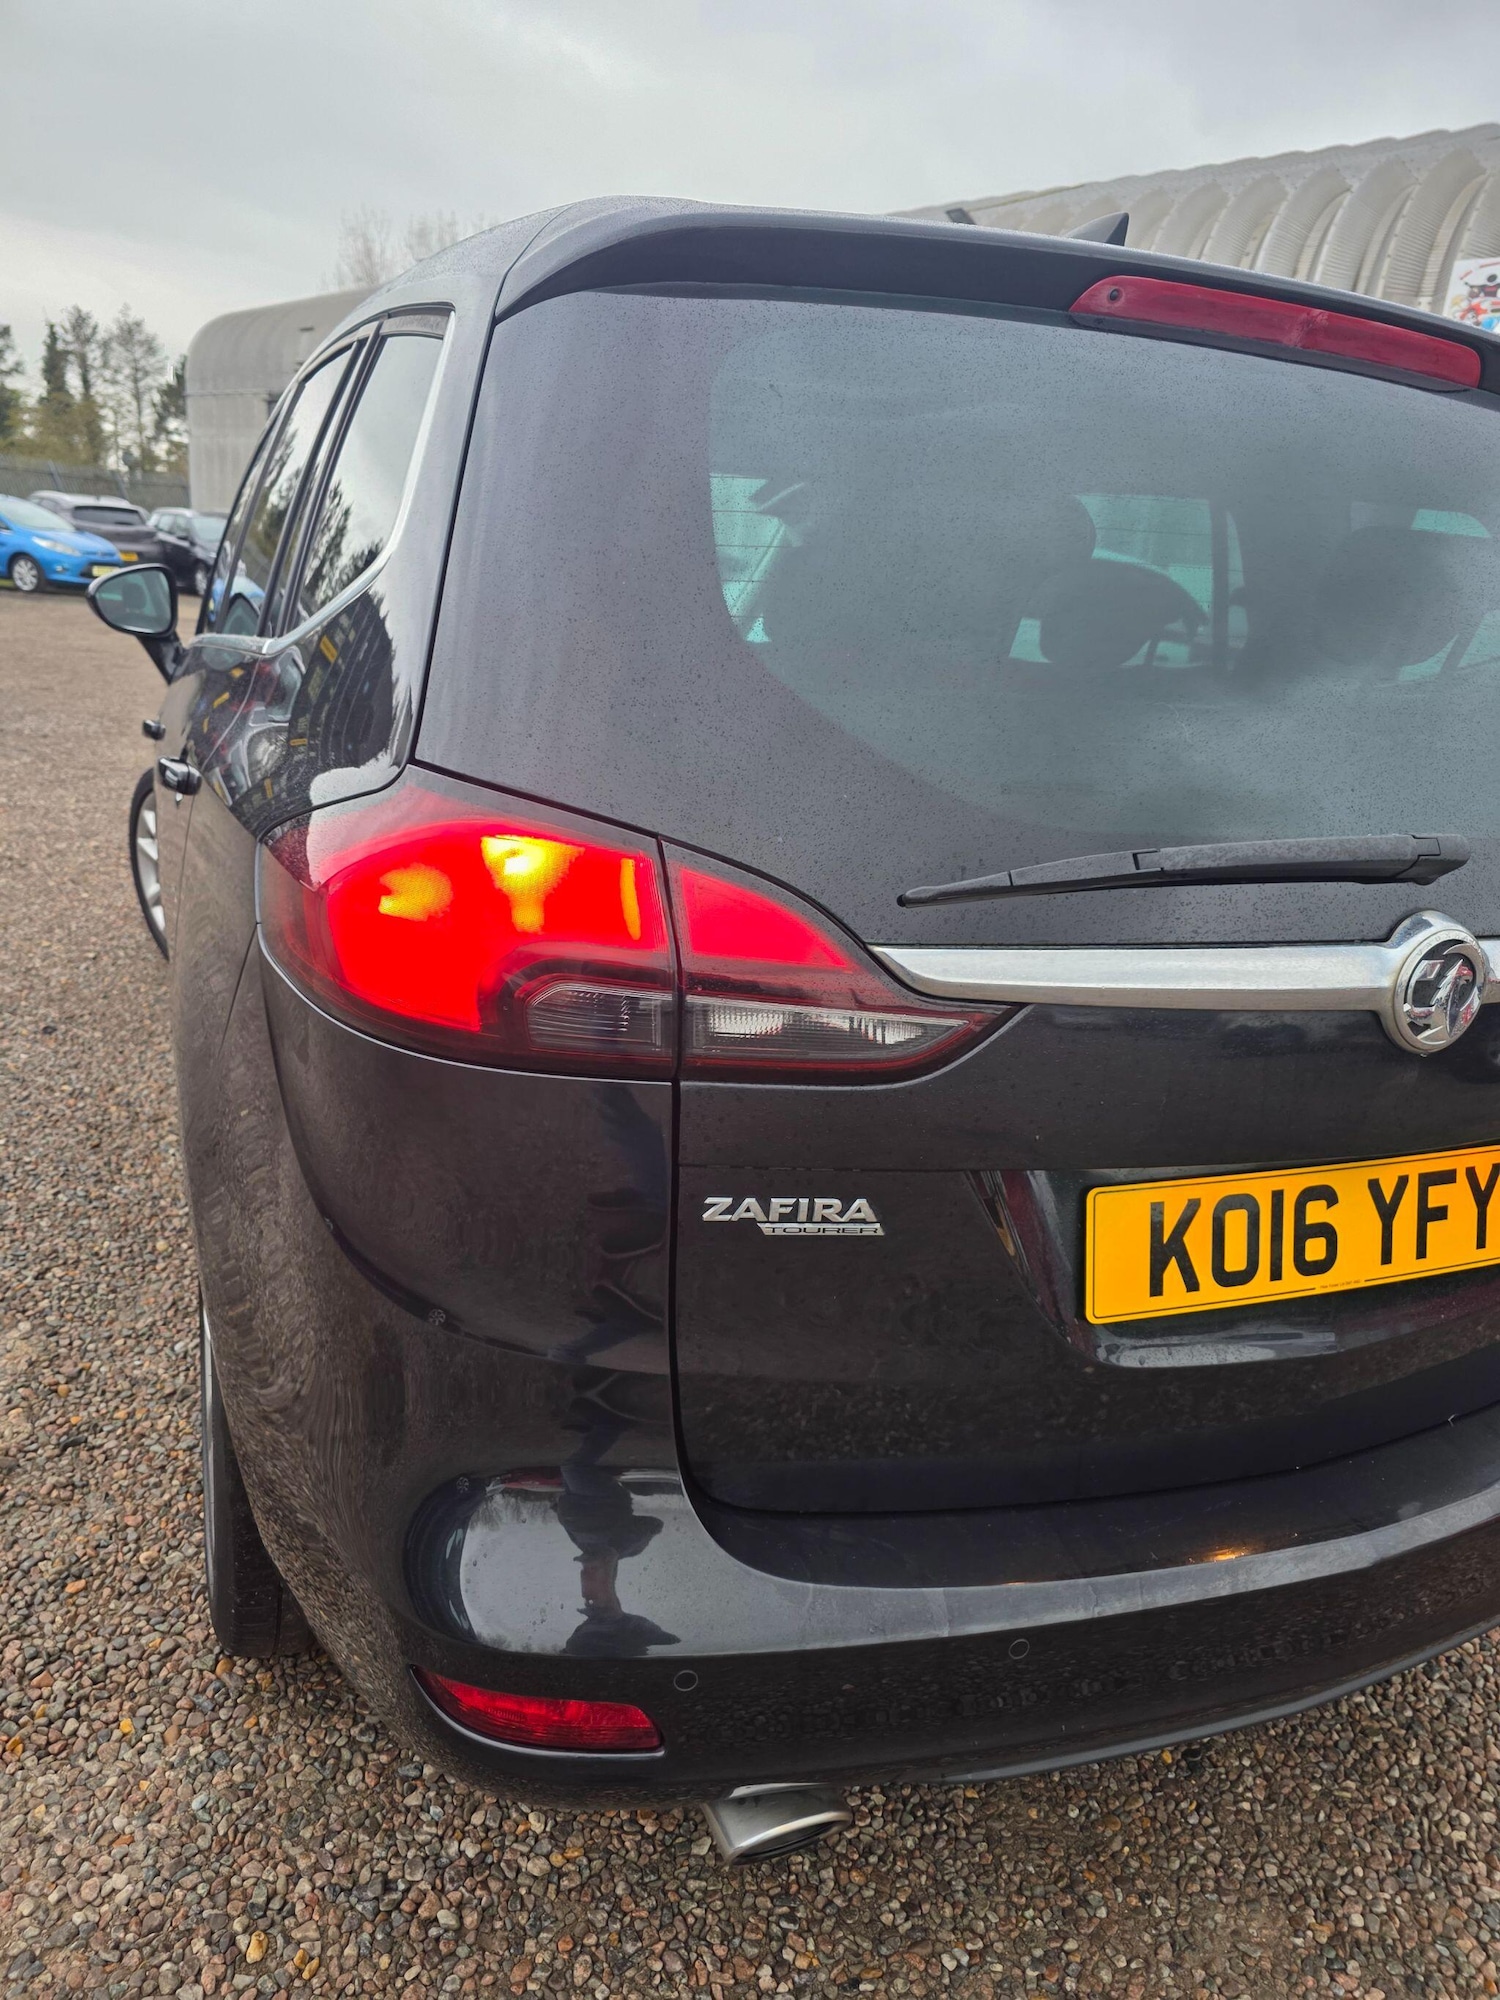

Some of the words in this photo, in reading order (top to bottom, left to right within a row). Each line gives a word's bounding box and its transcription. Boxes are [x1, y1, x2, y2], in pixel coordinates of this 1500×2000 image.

[702, 1197, 878, 1222] ZAFIRA
[764, 1225, 879, 1235] TOURER
[1149, 1184, 1339, 1298] KO16
[1367, 1162, 1500, 1266] YFY
